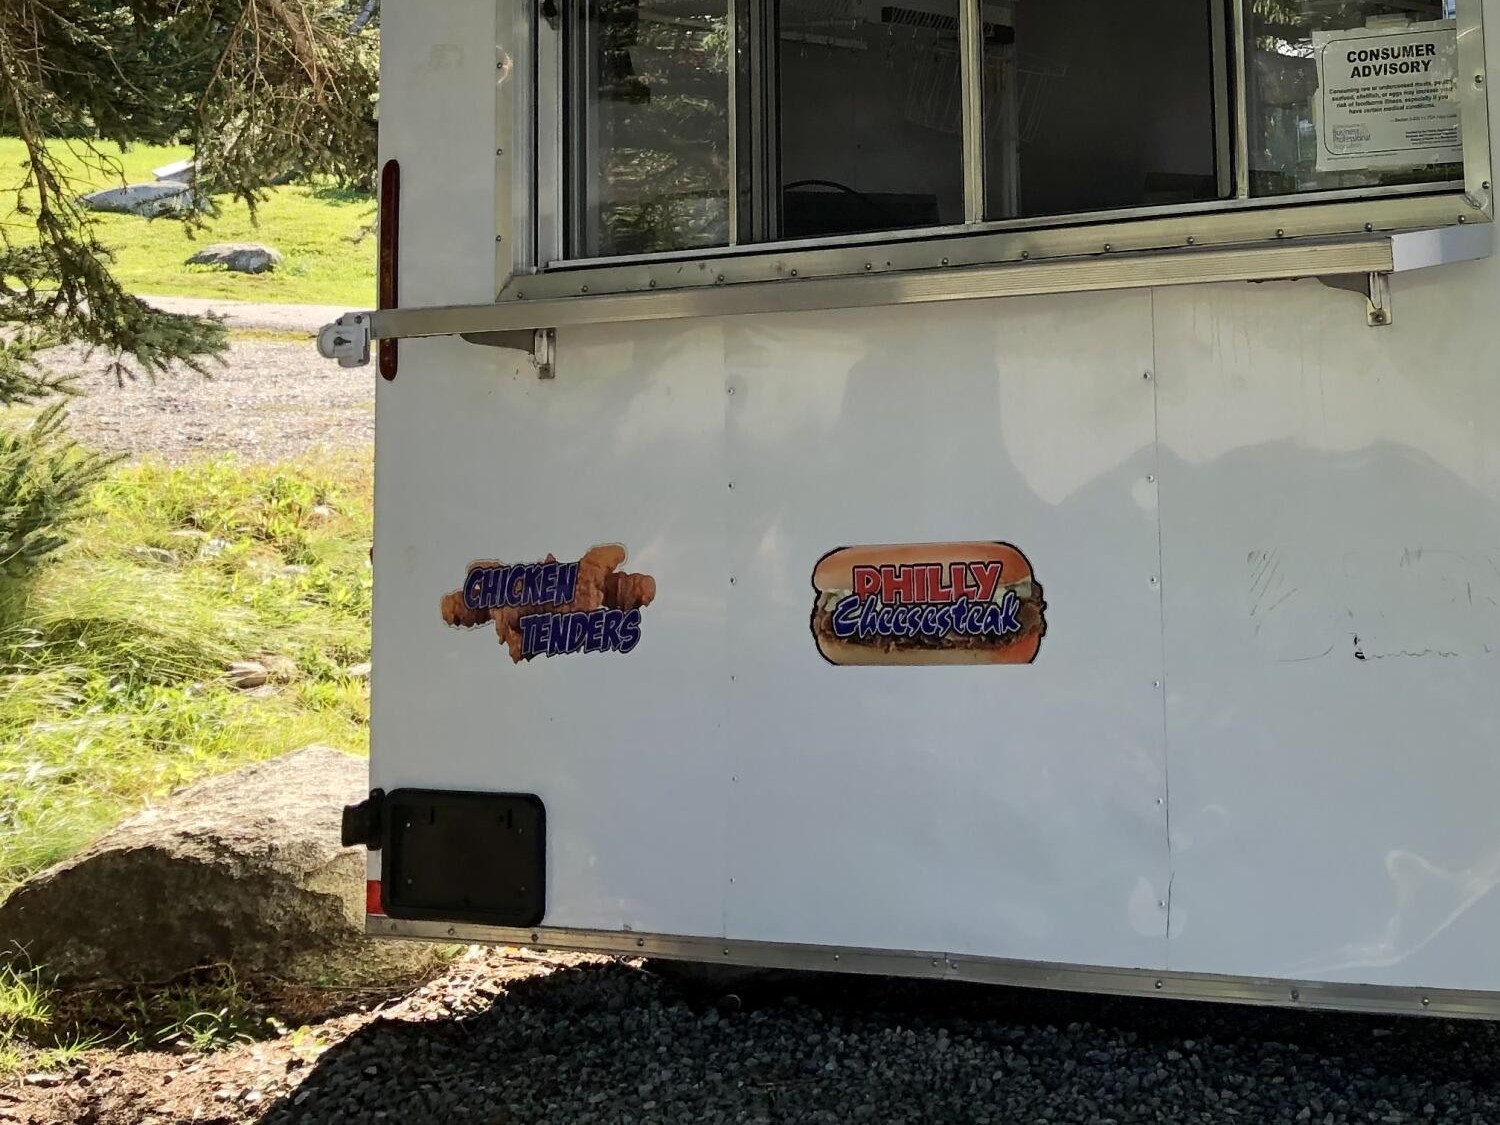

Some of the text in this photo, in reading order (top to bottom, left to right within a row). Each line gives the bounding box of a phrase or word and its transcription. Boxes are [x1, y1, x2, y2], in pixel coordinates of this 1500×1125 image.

[1346, 43, 1436, 64] CONSUMER
[1350, 60, 1432, 78] ADVISORY
[1379, 82, 1413, 90] undercooked
[1405, 95, 1432, 103] especially
[464, 562, 579, 609] CHICKEN
[852, 562, 1002, 604] PHILLY
[832, 592, 1021, 639] Cheesesteak
[520, 609, 641, 657] TENDERS
